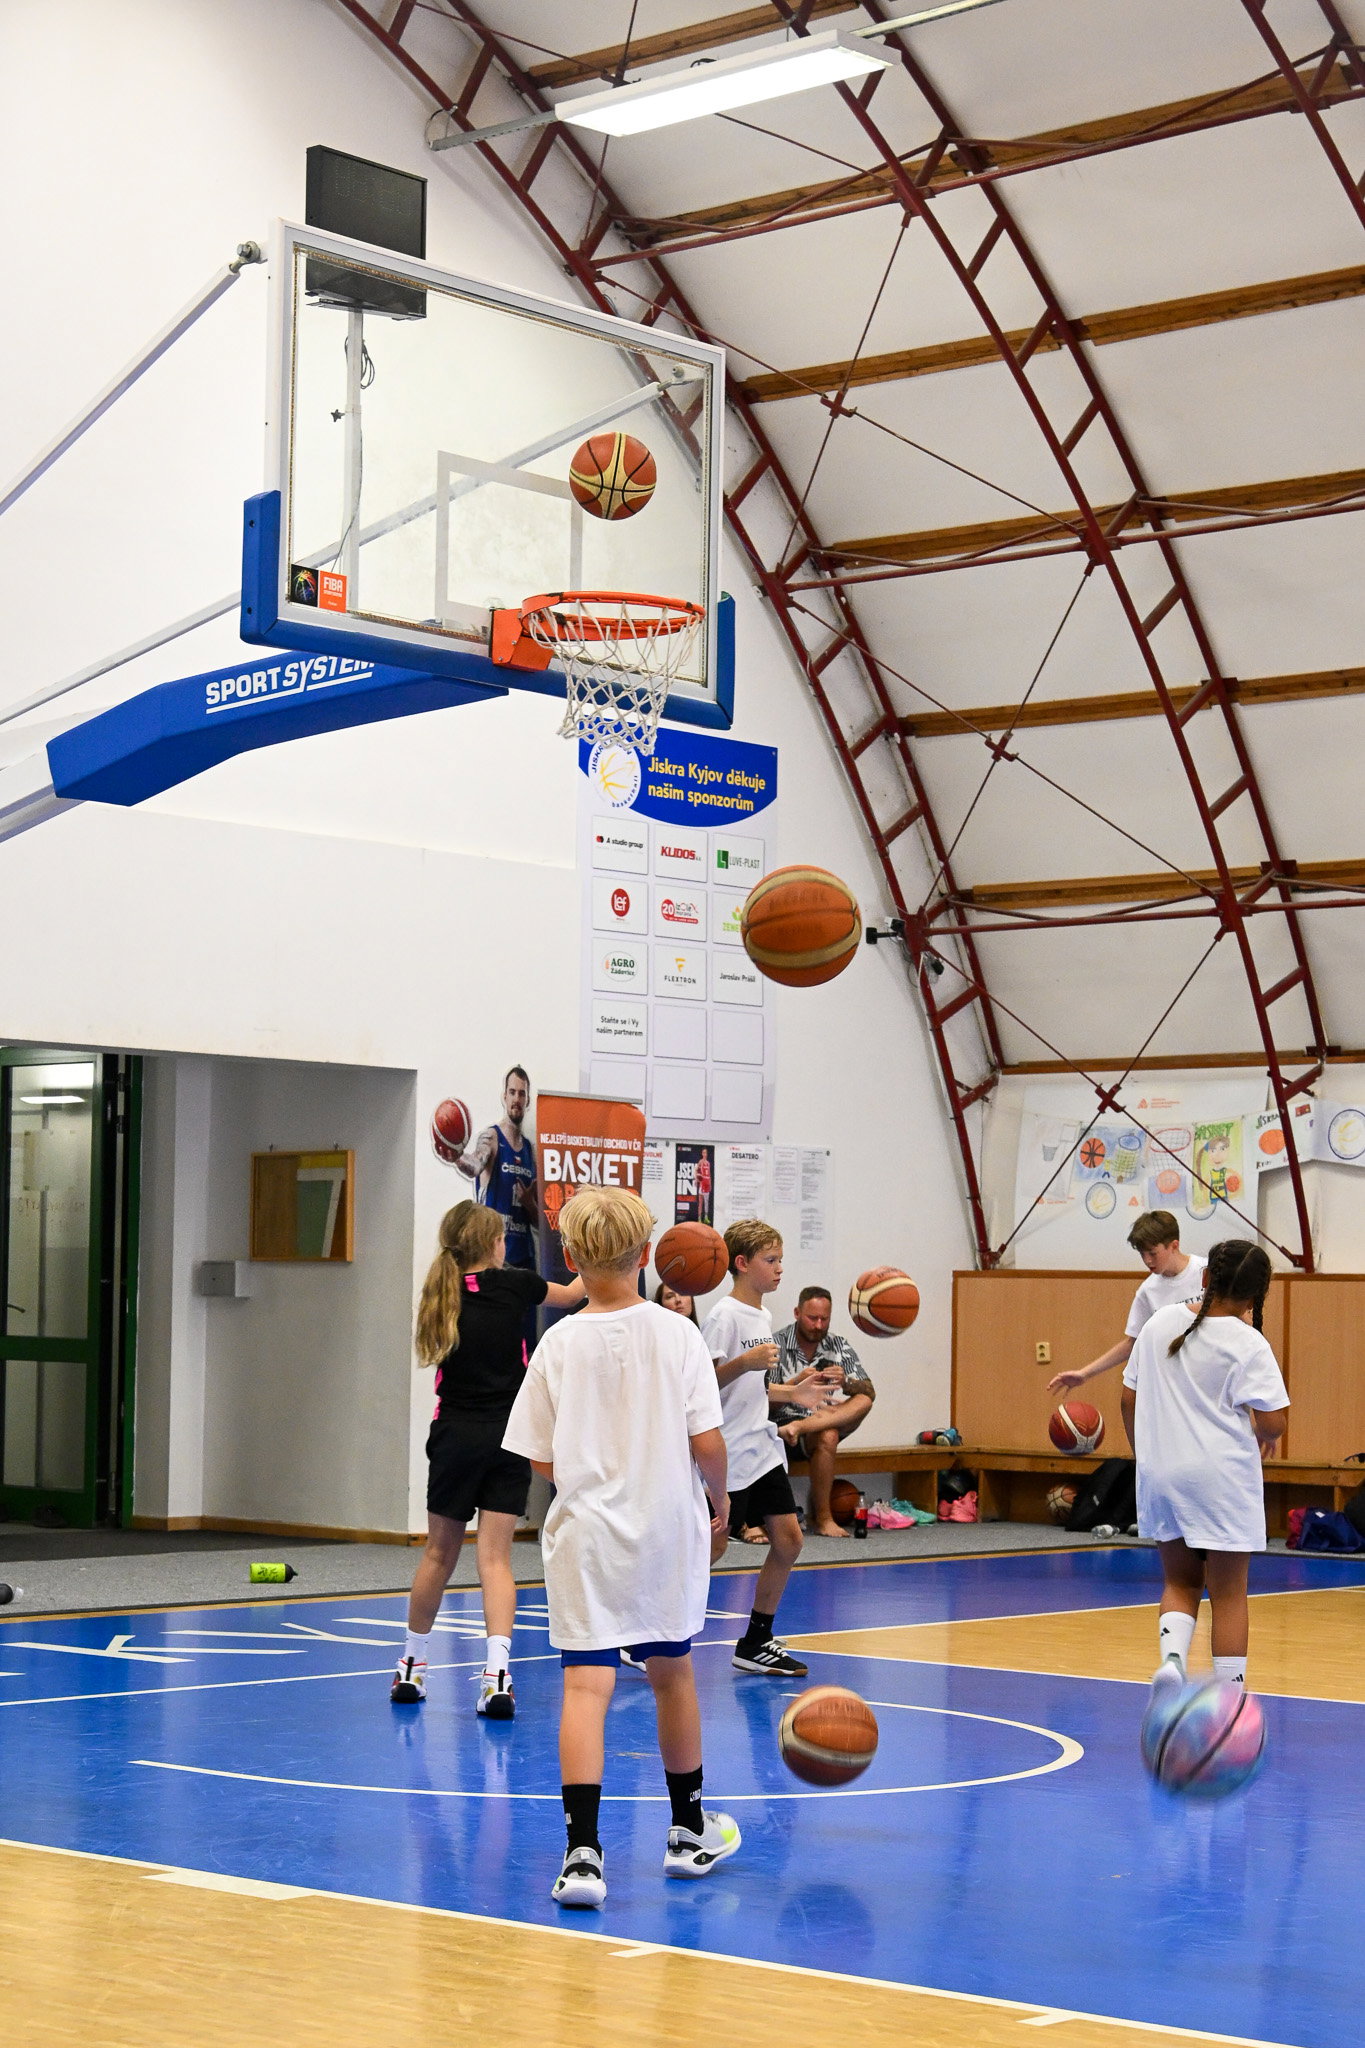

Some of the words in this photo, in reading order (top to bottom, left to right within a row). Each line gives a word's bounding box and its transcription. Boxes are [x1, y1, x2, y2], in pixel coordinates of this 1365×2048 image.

[323, 576, 343, 593] FIBA
[206, 666, 281, 705] SPORT
[648, 757, 685, 777] Jiskra
[688, 762, 723, 785] Kyjov
[726, 769, 766, 793] děkuje
[648, 782, 684, 801] našim
[687, 791, 754, 812] sponzorům
[628, 841, 644, 849] group
[661, 846, 696, 861] KLIDOS
[729, 857, 760, 869] LUVE-PLAST
[662, 903, 675, 916] 20
[723, 922, 742, 933] ZENE
[611, 958, 635, 969] AGRO
[664, 975, 697, 985] FLEXTRON
[720, 973, 741, 981] Jaroslav
[631, 1018, 639, 1028] Vy
[731, 1152, 760, 1160] DESATERO
[501, 1162, 532, 1178] ČESKO
[543, 1148, 639, 1187] BASKET
[677, 1179, 698, 1196] IN
